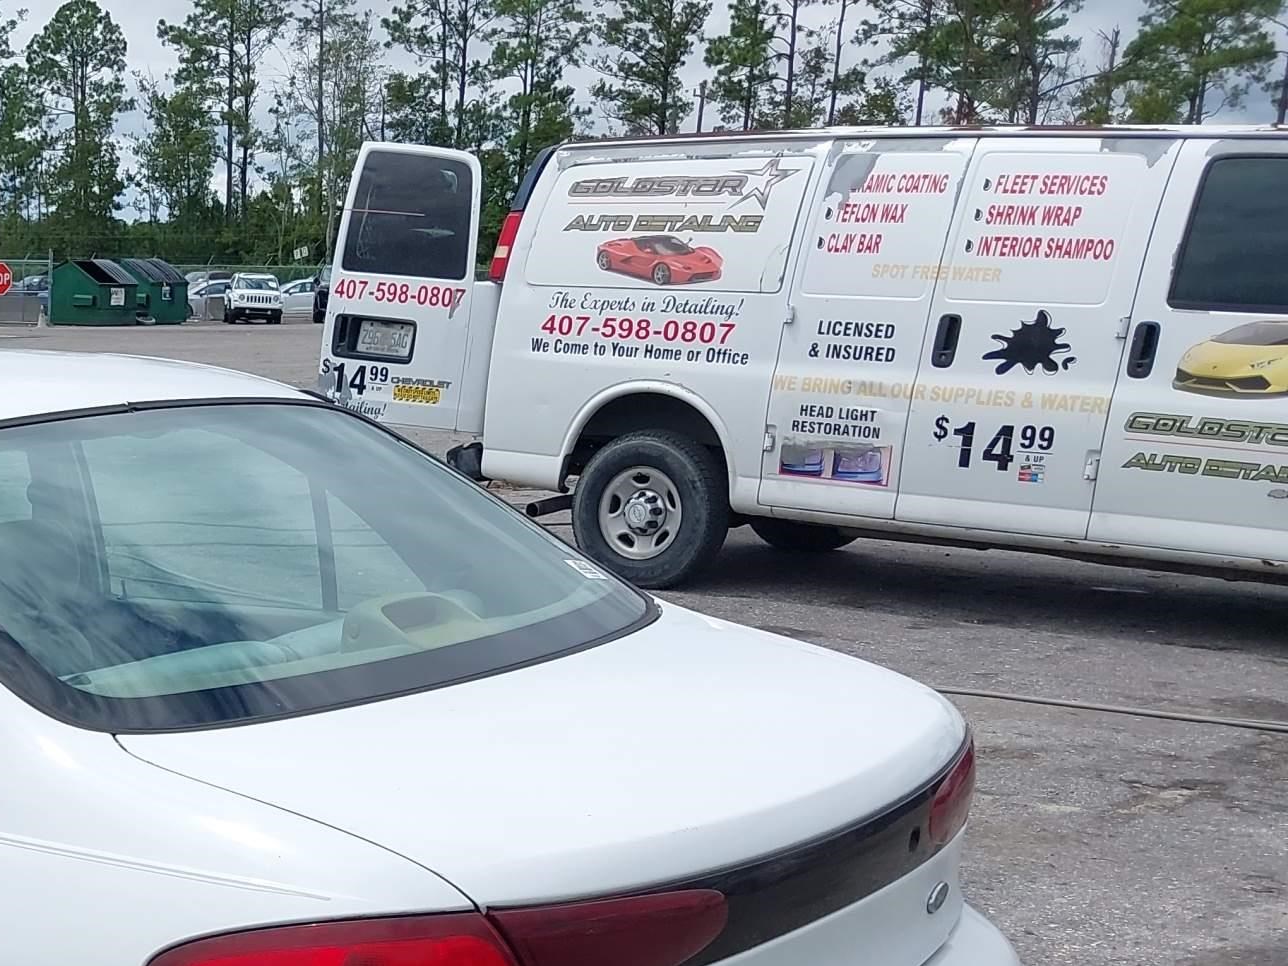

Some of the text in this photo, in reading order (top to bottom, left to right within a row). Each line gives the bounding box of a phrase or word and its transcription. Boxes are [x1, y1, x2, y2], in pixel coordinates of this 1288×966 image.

[897, 174, 949, 194] COATING
[994, 174, 1108, 196] FLEET SERVICES
[563, 214, 764, 233] AUTO DETAILING
[880, 203, 908, 224] WAX
[985, 205, 1082, 227] SHRINK WRAP
[827, 233, 882, 254] CLAY BAR
[976, 236, 1115, 260] INTERIOR SHAMPOO
[872, 263, 1002, 283] SPOT FREE WATER
[335, 278, 467, 308] 407-598-0807
[549, 291, 745, 321] The Experts in Detailing!
[541, 314, 736, 345] 407-598-0807
[817, 319, 896, 339] LICENSED
[530, 337, 749, 366] We Come to Your Home or Office
[808, 342, 896, 363] & INSURED
[774, 374, 798, 391] WE
[801, 376, 852, 395] BRING
[855, 379, 887, 398] ALL
[890, 381, 927, 401] OUR
[929, 384, 1016, 408] SUPPLIES
[1020, 391, 1033, 409] &
[799, 403, 878, 423] HEAD LIGHT
[791, 419, 881, 440] RESTORATION
[1033, 455, 1045, 463] UP
[1120, 452, 1202, 475] AUTO
